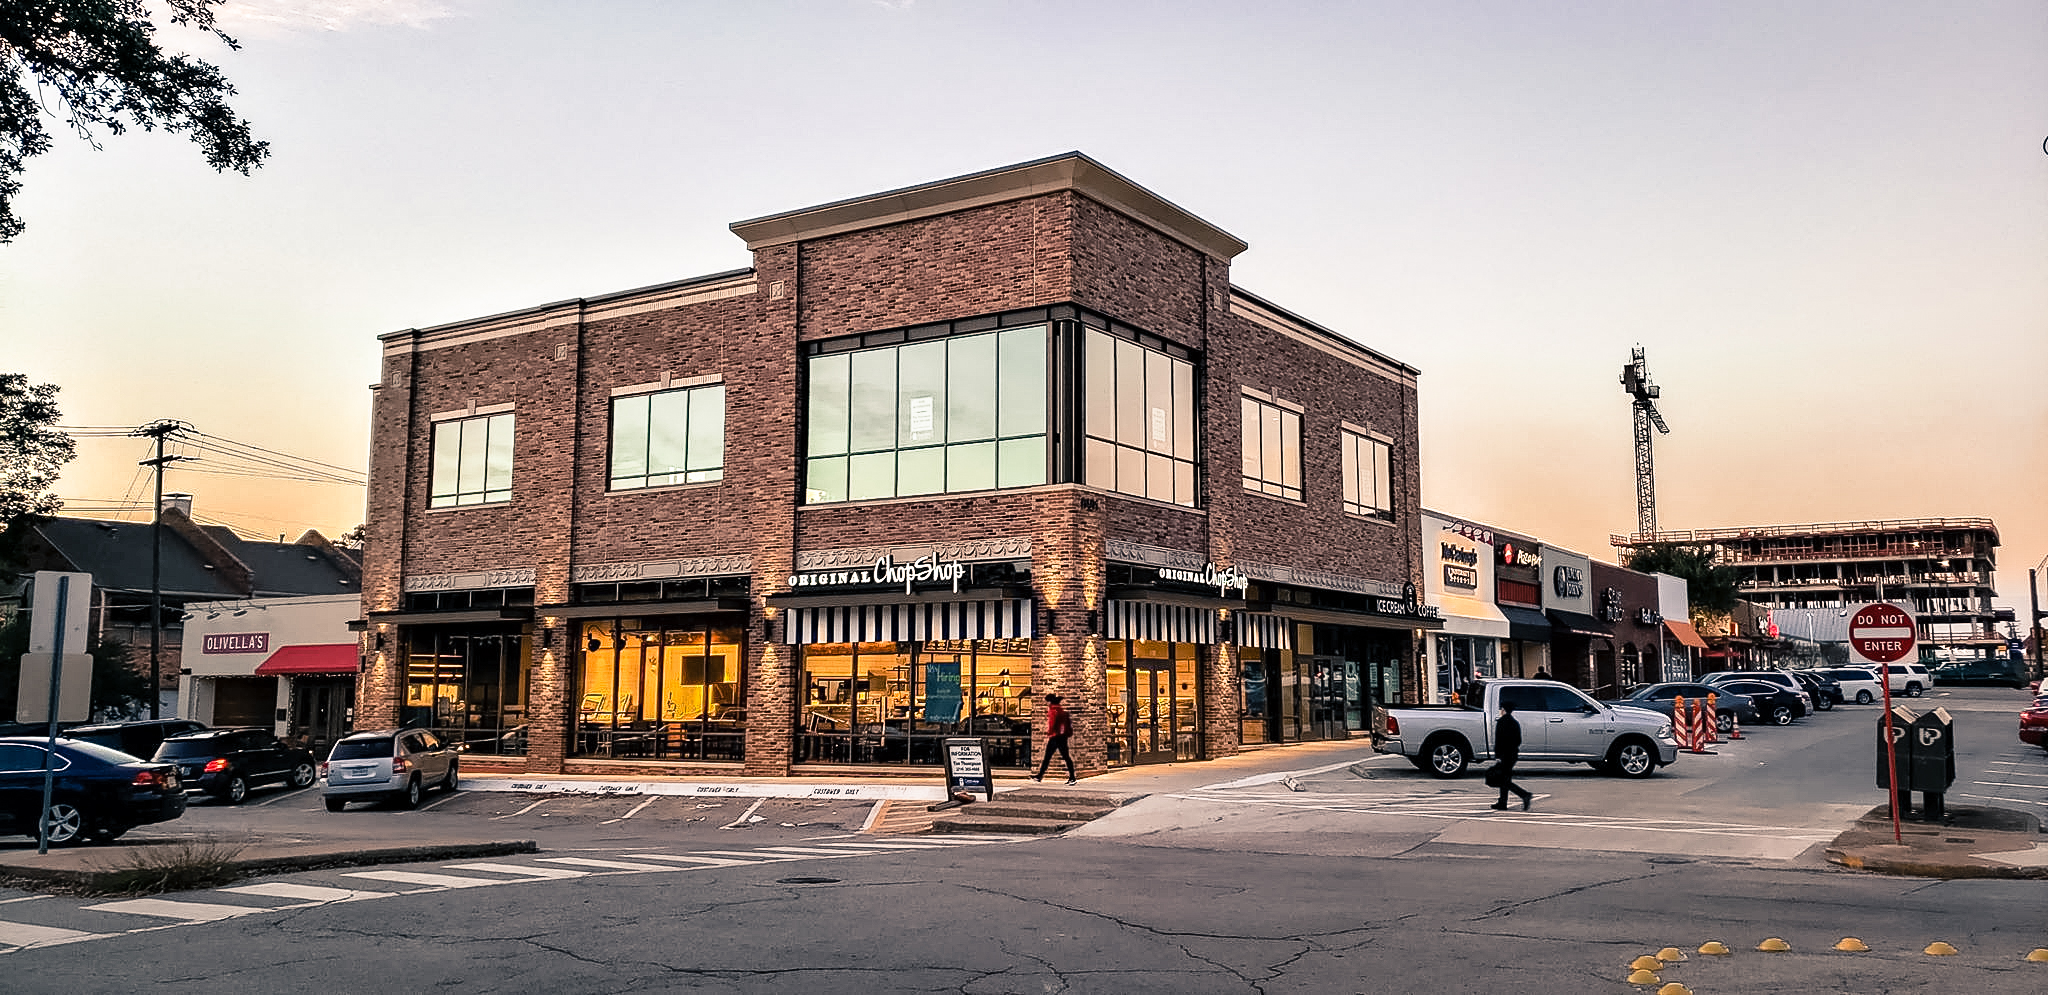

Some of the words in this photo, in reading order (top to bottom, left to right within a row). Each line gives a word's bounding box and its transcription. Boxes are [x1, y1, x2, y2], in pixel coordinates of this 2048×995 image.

[788, 571, 871, 587] ORIGINAL
[873, 551, 966, 596] ChopShop
[1159, 568, 1206, 584] ORIGINAL
[1206, 561, 1249, 600] ChopShop
[1857, 615, 1874, 625] DO
[1881, 614, 1905, 625] NOT
[207, 635, 263, 650] OLIVELLA'S
[1864, 641, 1902, 651] ENTER
